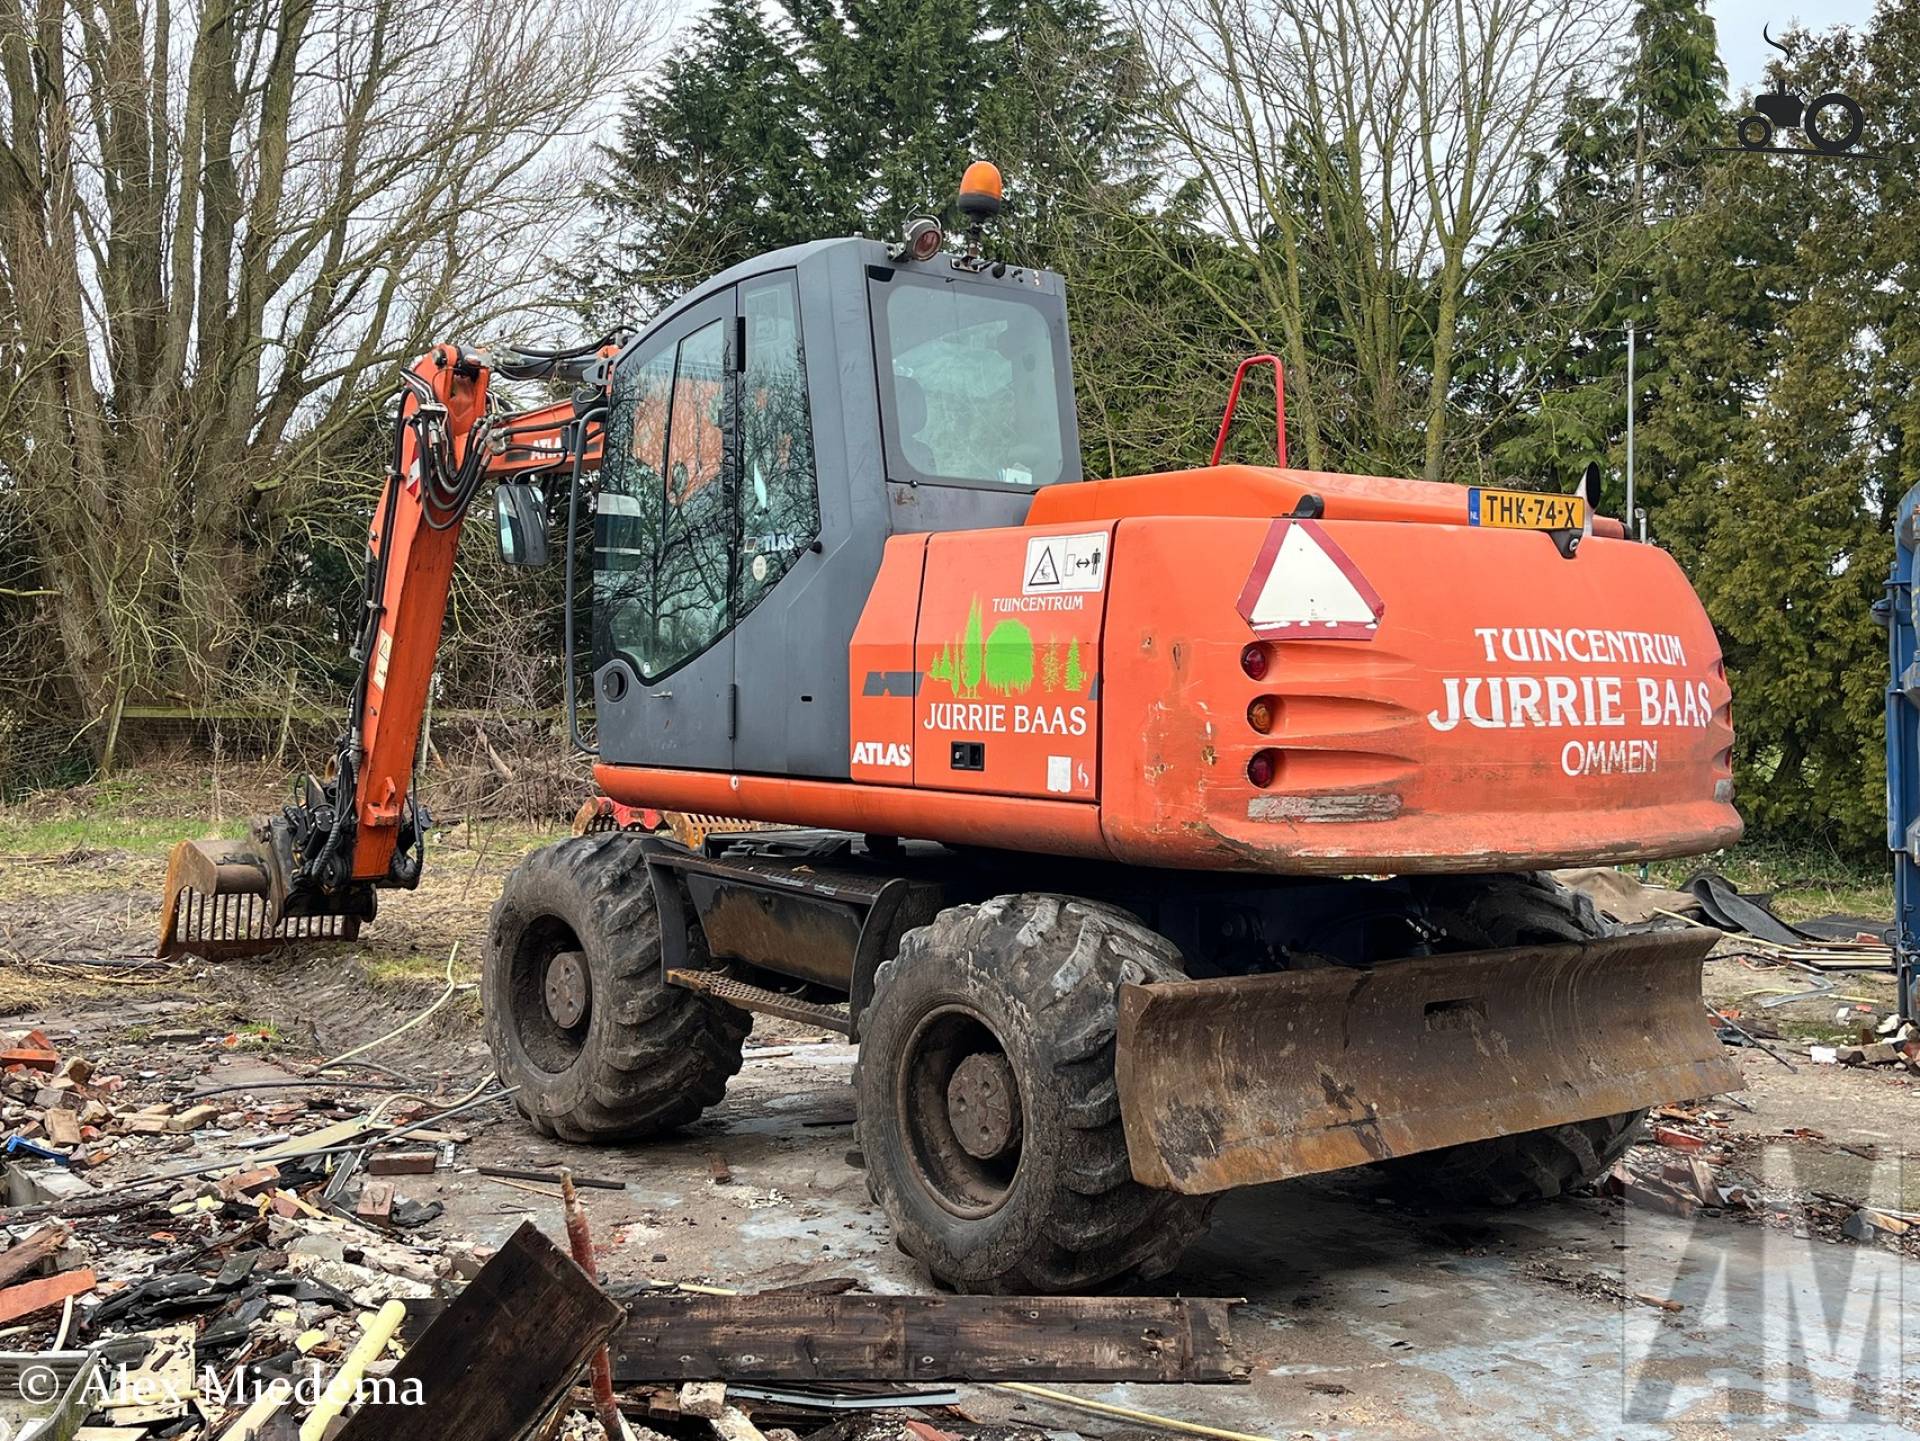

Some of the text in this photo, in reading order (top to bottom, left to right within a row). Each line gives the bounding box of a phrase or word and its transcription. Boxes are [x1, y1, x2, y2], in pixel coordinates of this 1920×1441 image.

[531, 437, 571, 460] ATLA
[1486, 495, 1576, 528] THK-74-X
[991, 595, 1084, 613] TUINCENTRUM
[1474, 627, 1687, 667] TUINCENTRUM
[923, 702, 1088, 736] JURRIE BAAS
[1426, 676, 1714, 732] JURRIE BAAS
[851, 741, 912, 767] ATLAS
[1561, 739, 1659, 777] OMMEN
